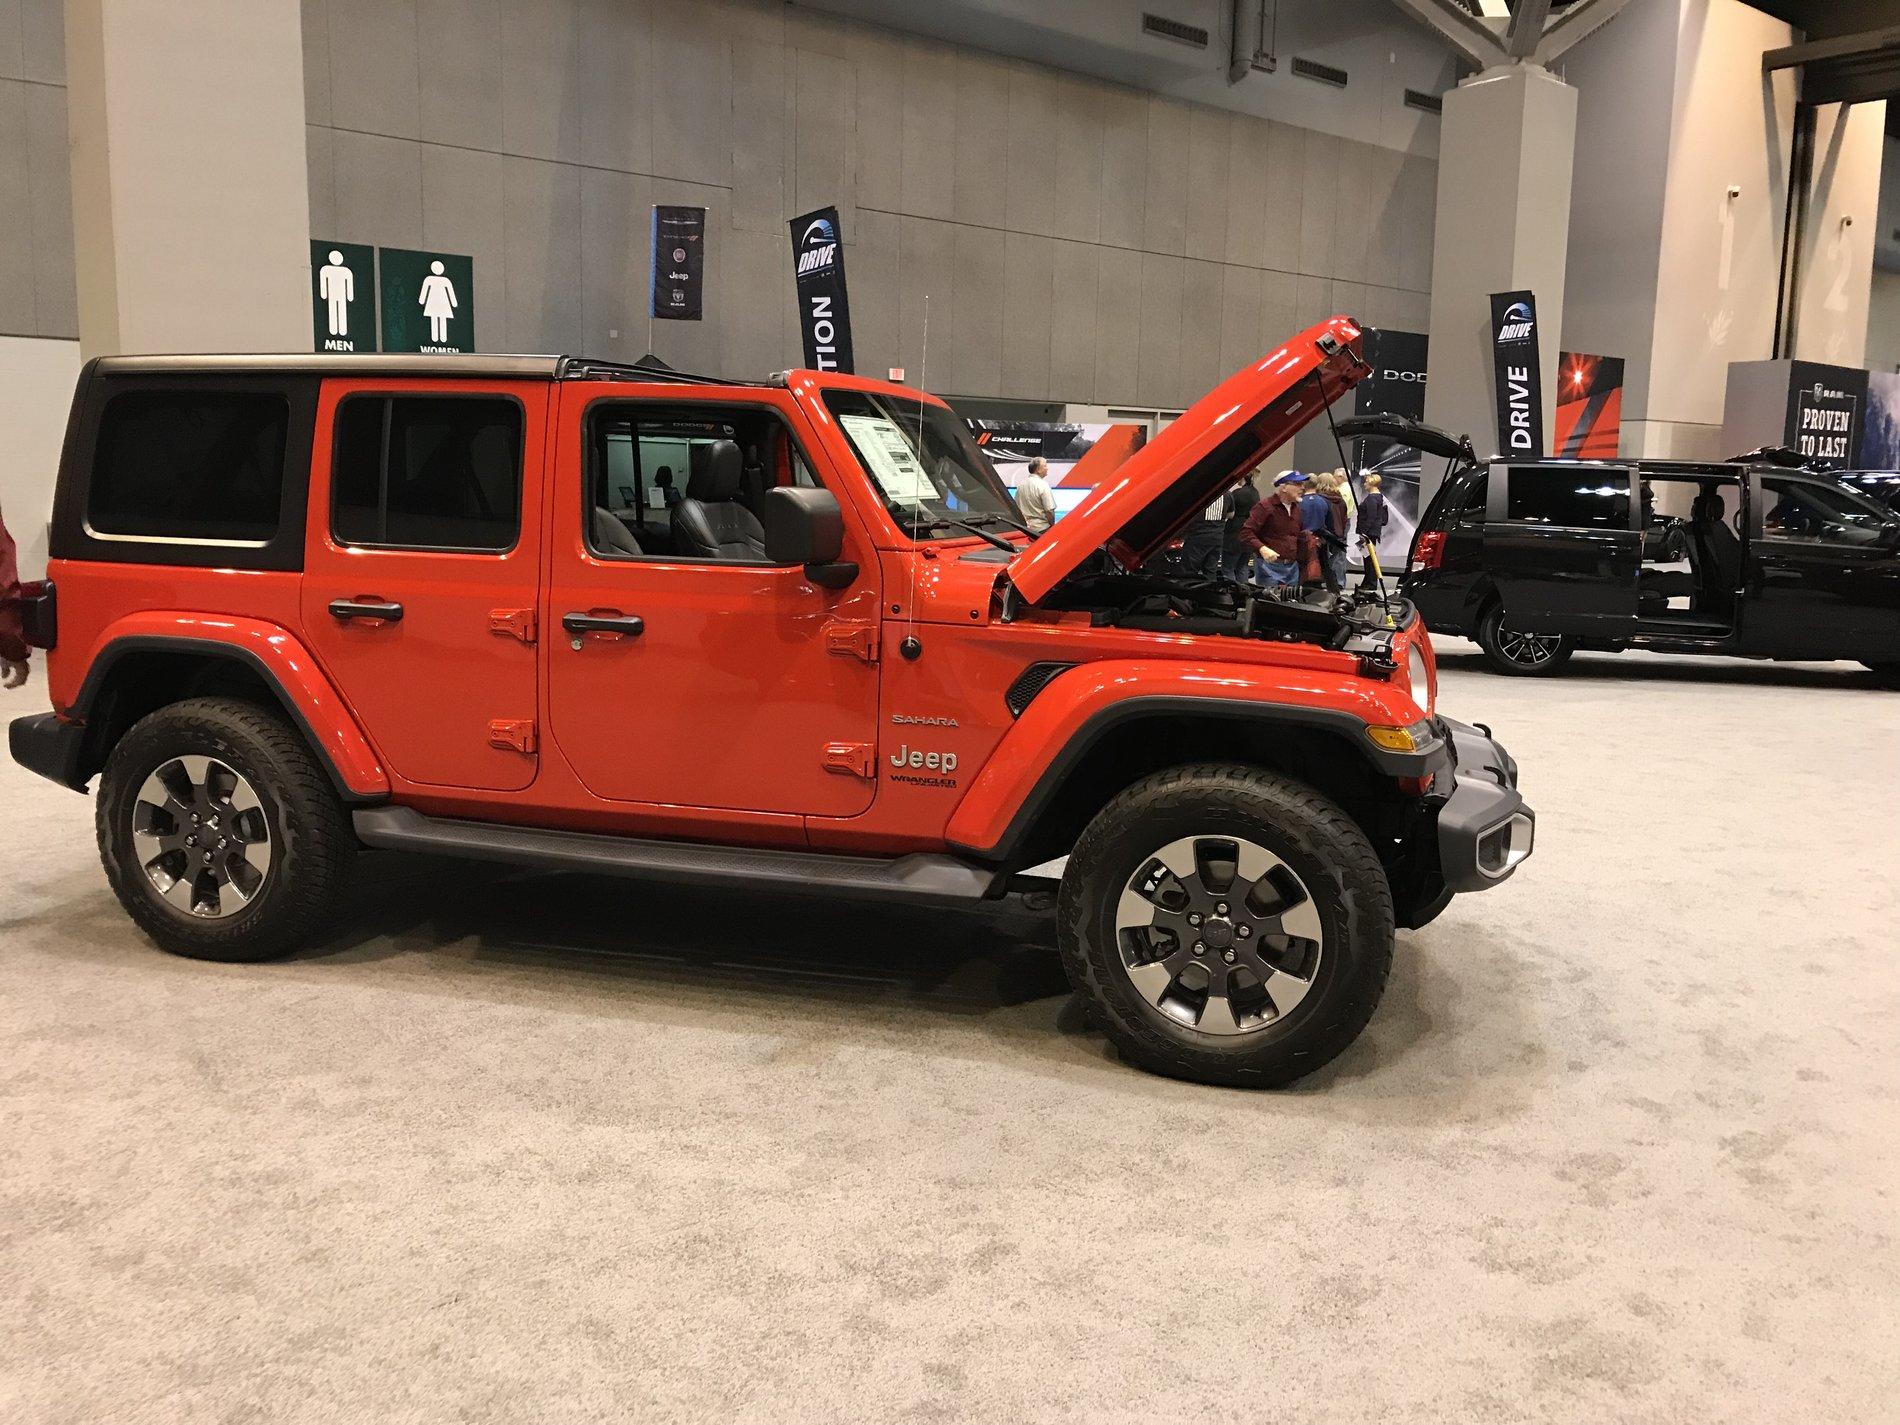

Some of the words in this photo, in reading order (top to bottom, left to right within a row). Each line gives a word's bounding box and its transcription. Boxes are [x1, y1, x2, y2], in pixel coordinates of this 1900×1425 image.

[798, 243, 837, 273] DRIVE
[669, 271, 689, 280] Jeep
[811, 296, 838, 373] TION
[1498, 322, 1533, 340] DRIVE
[324, 339, 354, 352] MEN
[1823, 389, 1845, 399] RAM
[1508, 366, 1532, 449] DRIVE
[1802, 408, 1850, 432] PROVEN
[991, 436, 1042, 444] CHALLENGE
[1800, 435, 1815, 457] TO
[1817, 436, 1847, 458] LAST
[891, 714, 959, 728] SAHARA
[890, 744, 958, 774] Jeep
[890, 774, 957, 786] WRANGLER
